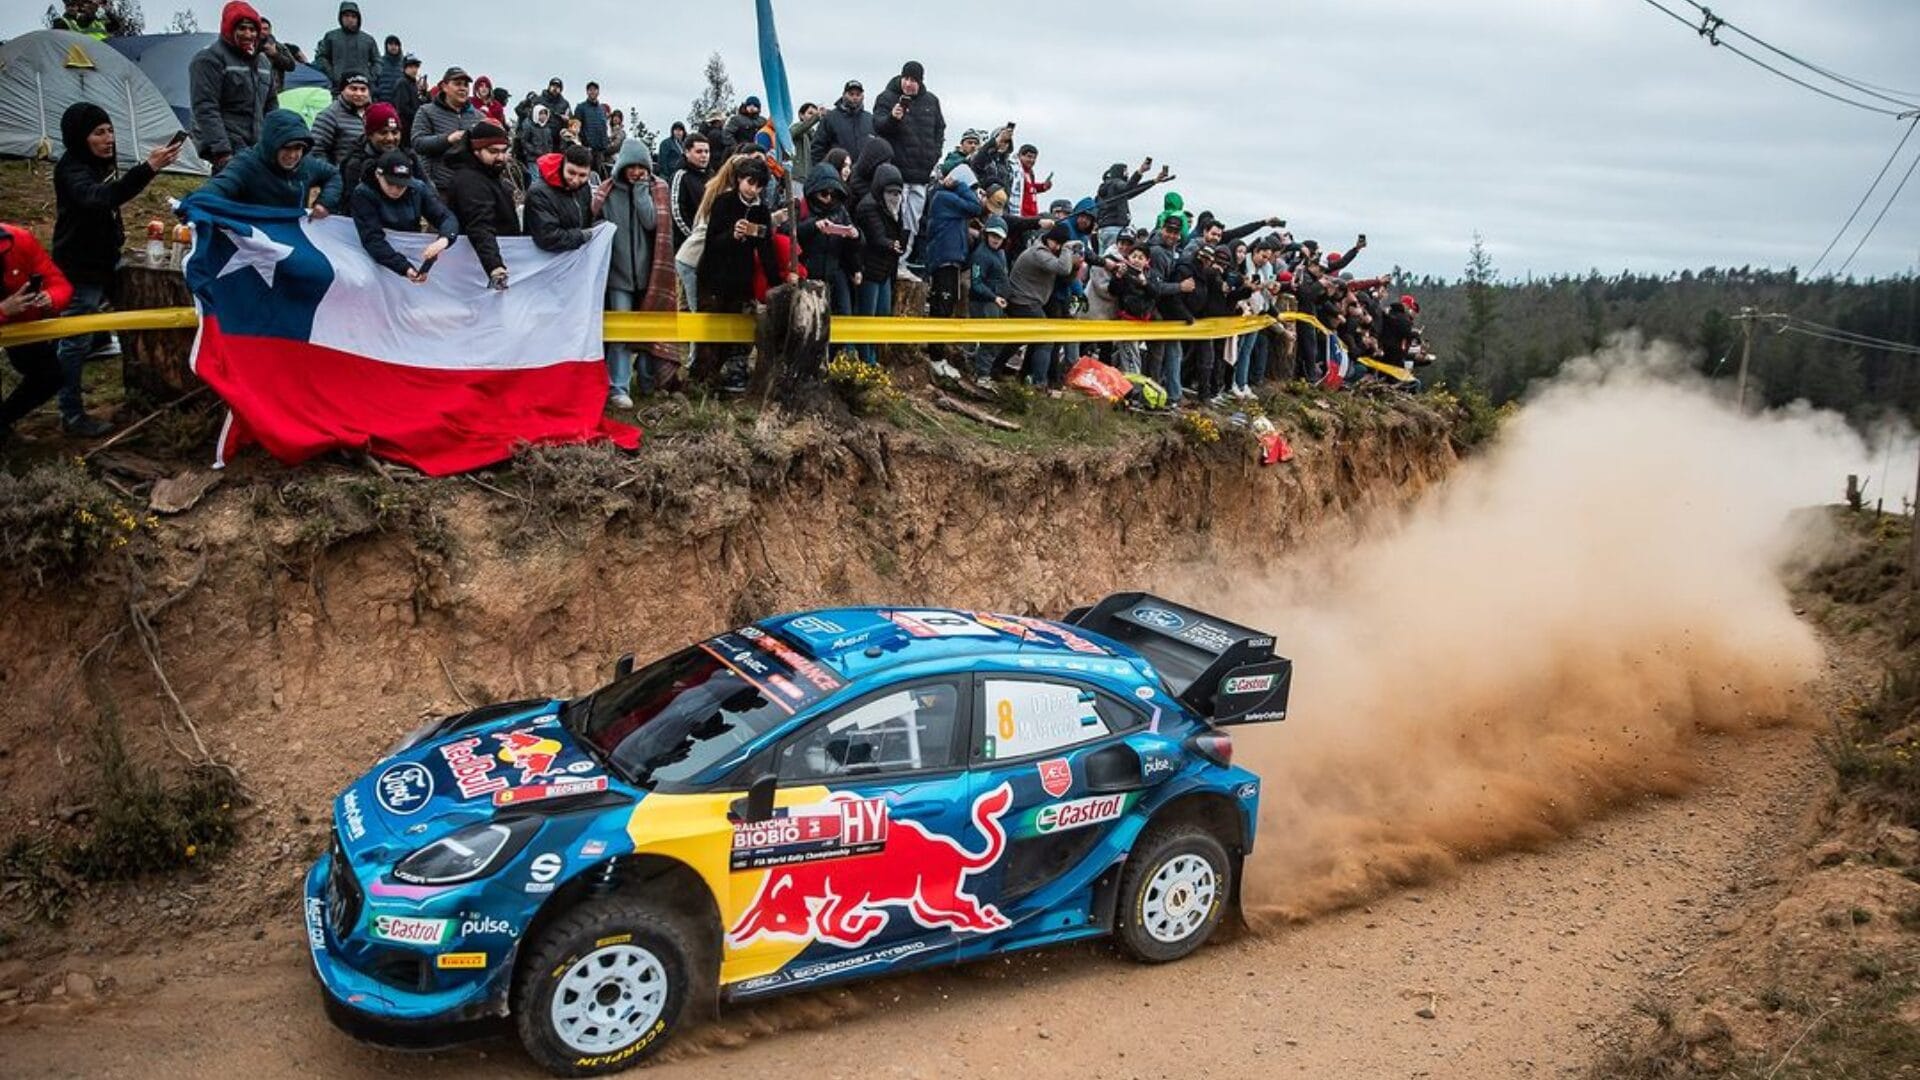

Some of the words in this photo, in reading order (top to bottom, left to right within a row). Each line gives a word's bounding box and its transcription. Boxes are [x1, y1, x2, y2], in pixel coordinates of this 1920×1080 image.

[1237, 677, 1270, 690] Castrol
[997, 699, 1015, 739] 8
[381, 767, 427, 807] Ford
[843, 799, 885, 844] HY
[1057, 795, 1121, 827] Castrol
[390, 918, 441, 941] Castrol
[461, 916, 509, 937] pulse
